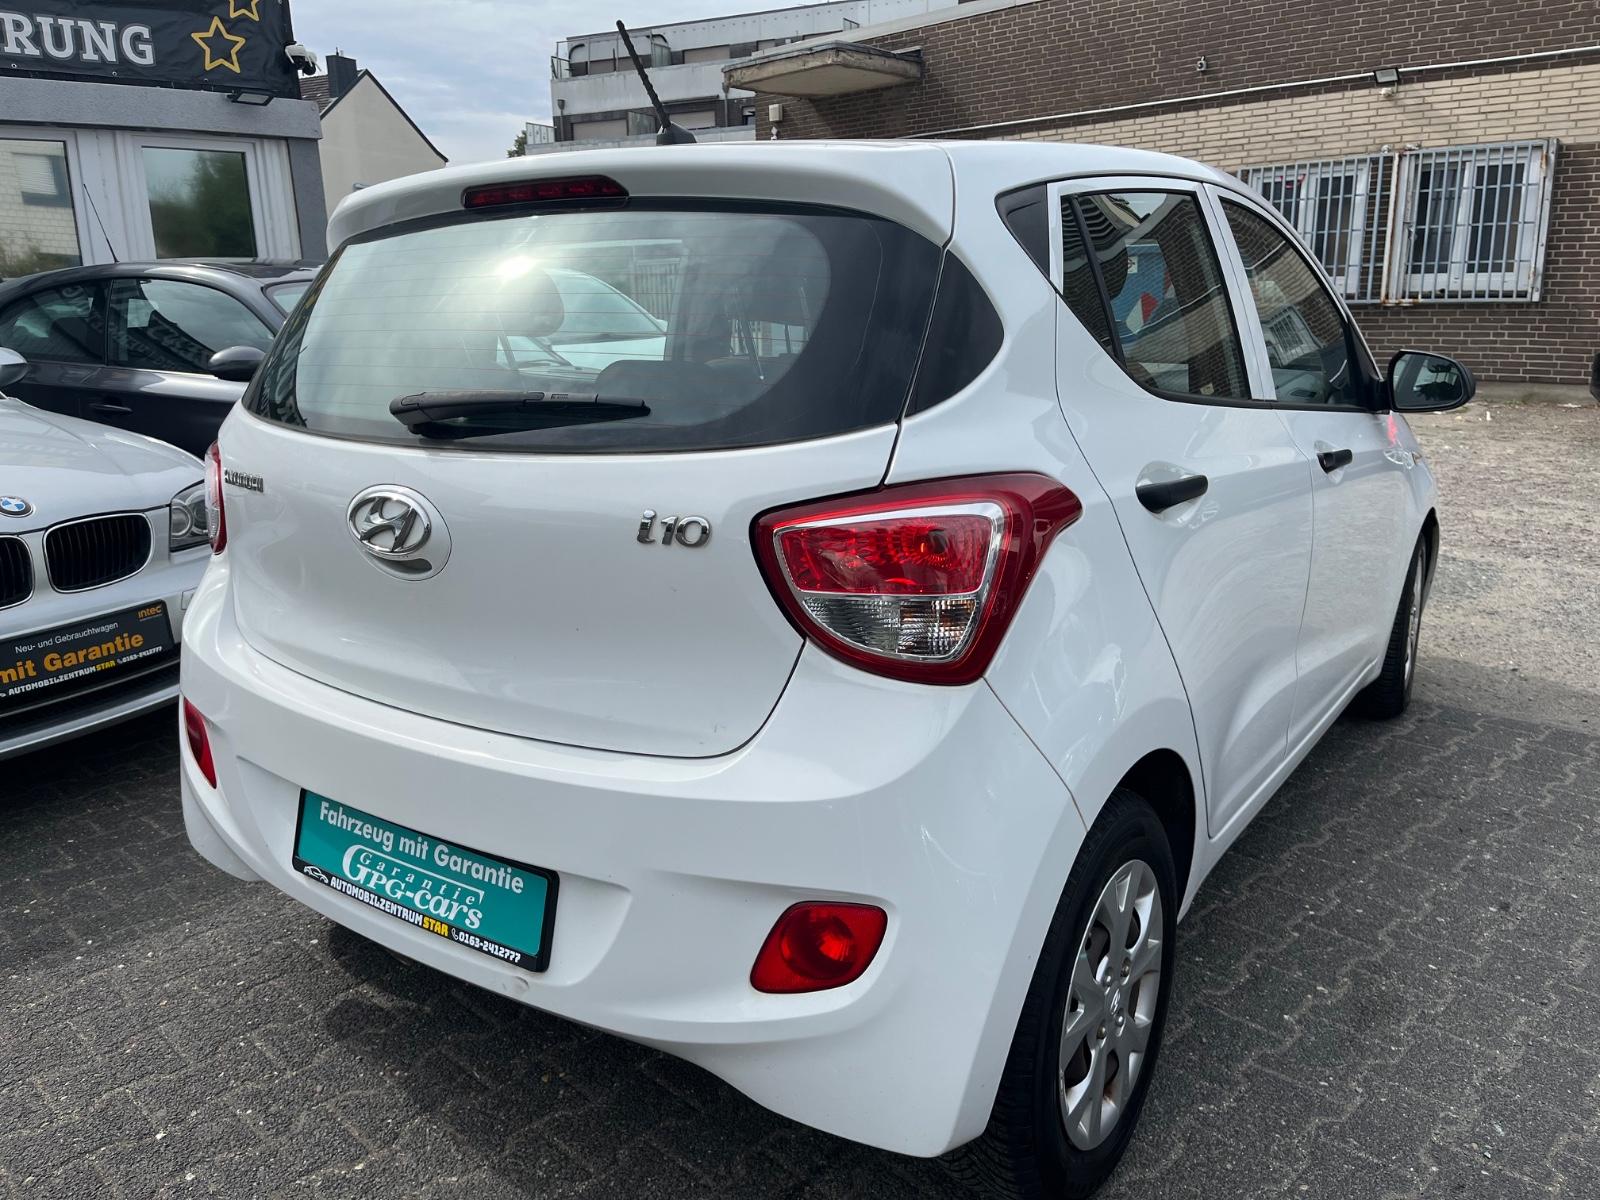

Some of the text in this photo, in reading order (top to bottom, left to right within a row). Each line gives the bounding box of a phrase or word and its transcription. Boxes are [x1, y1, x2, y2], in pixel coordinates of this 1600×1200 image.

[636, 509, 711, 548] i10
[15, 621, 119, 655] Neu- und Gebrauchtwagen
[43, 632, 145, 672] Garantie
[319, 801, 524, 894] Fahrzeug mit Garantie
[360, 851, 475, 905] Garantie
[458, 931, 521, 963] 0163-2412777
